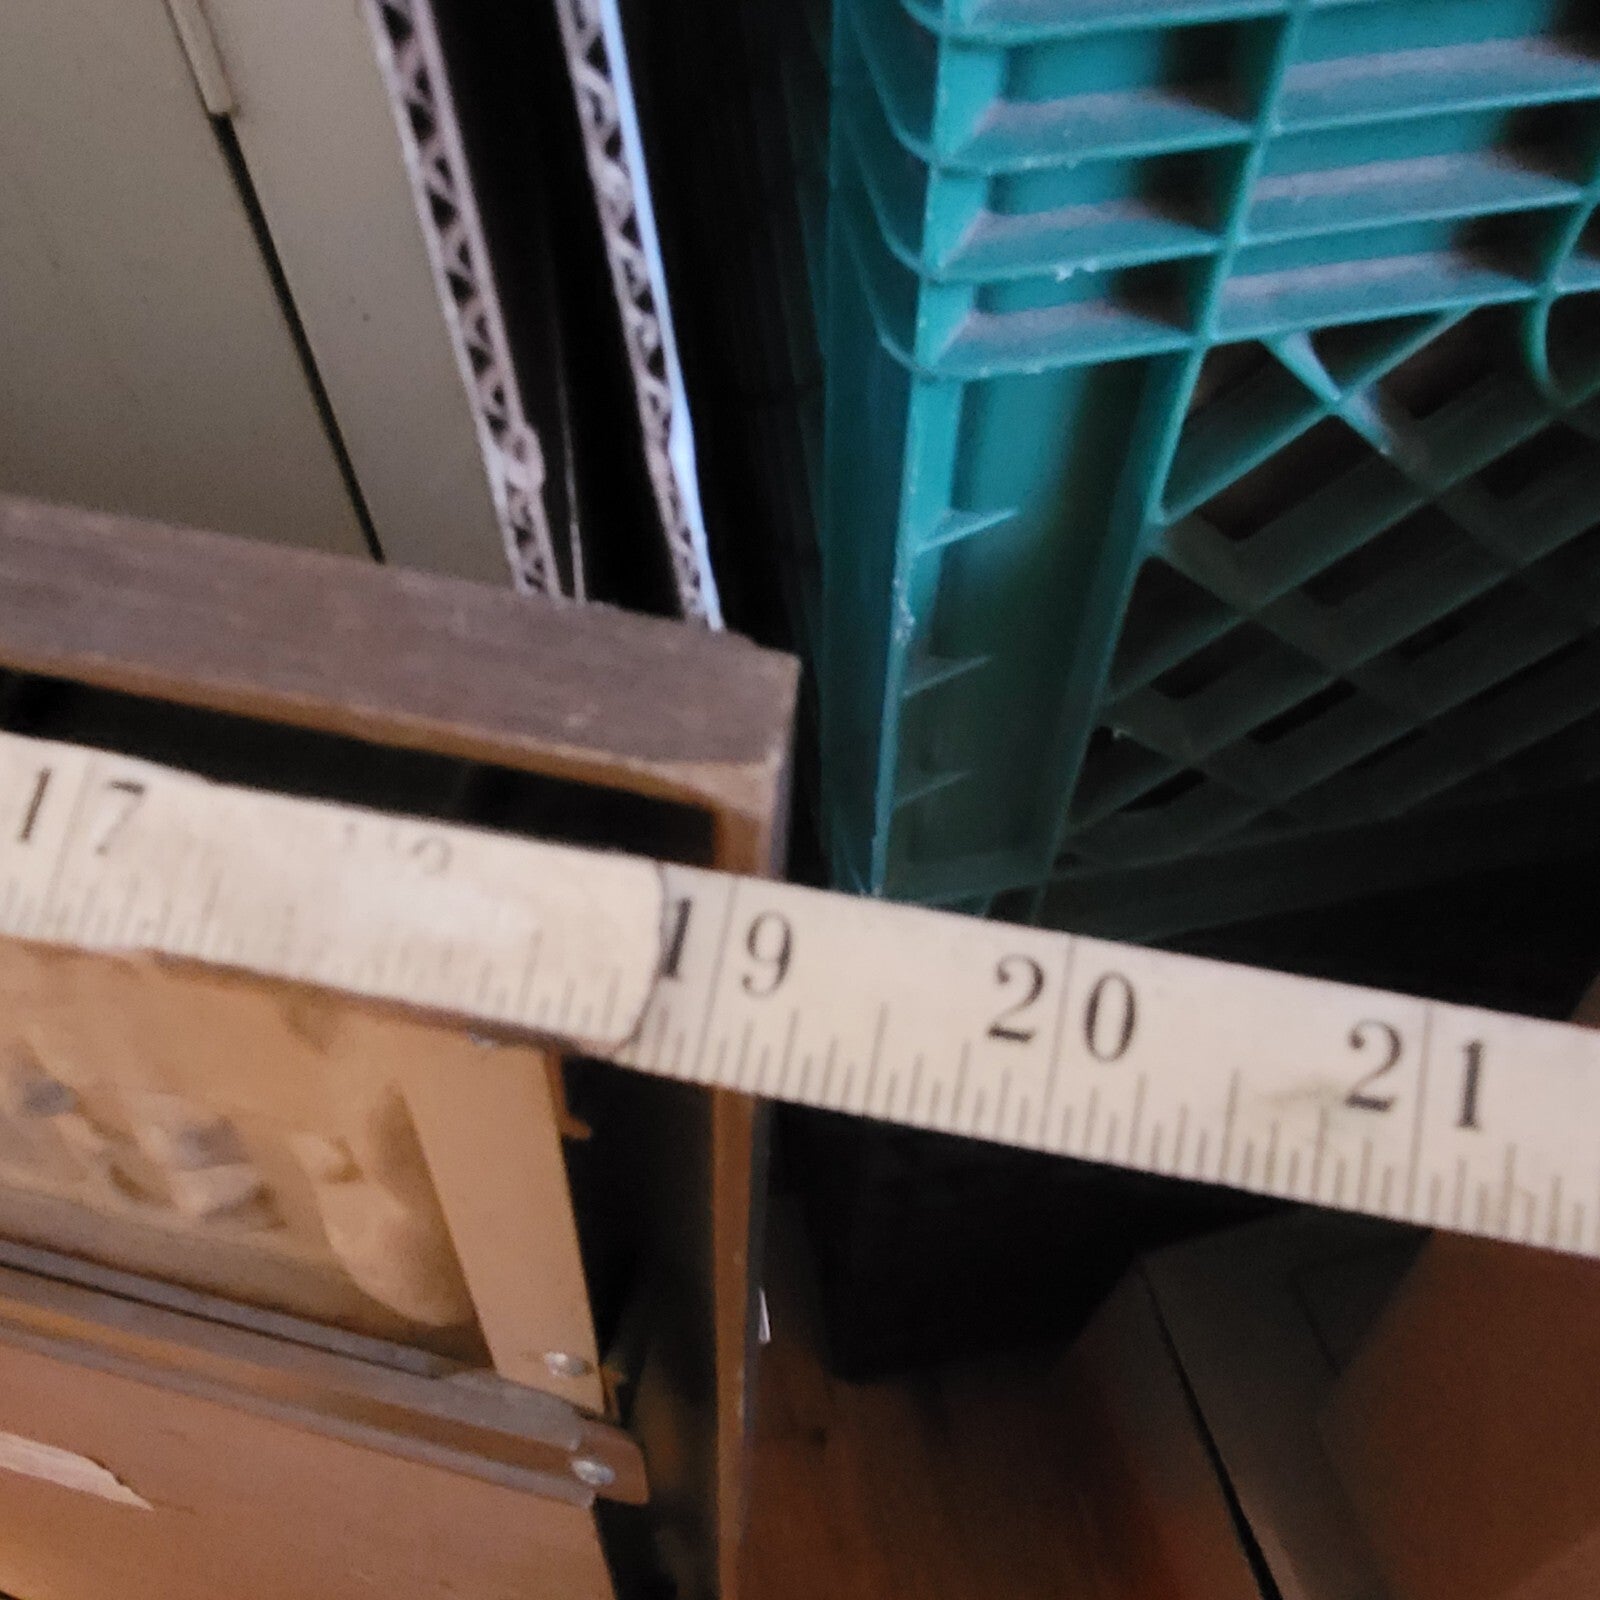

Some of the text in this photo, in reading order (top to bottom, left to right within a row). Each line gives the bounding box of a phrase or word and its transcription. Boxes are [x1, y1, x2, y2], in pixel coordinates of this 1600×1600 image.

[19, 767, 1485, 1133] 17 19 20 21
